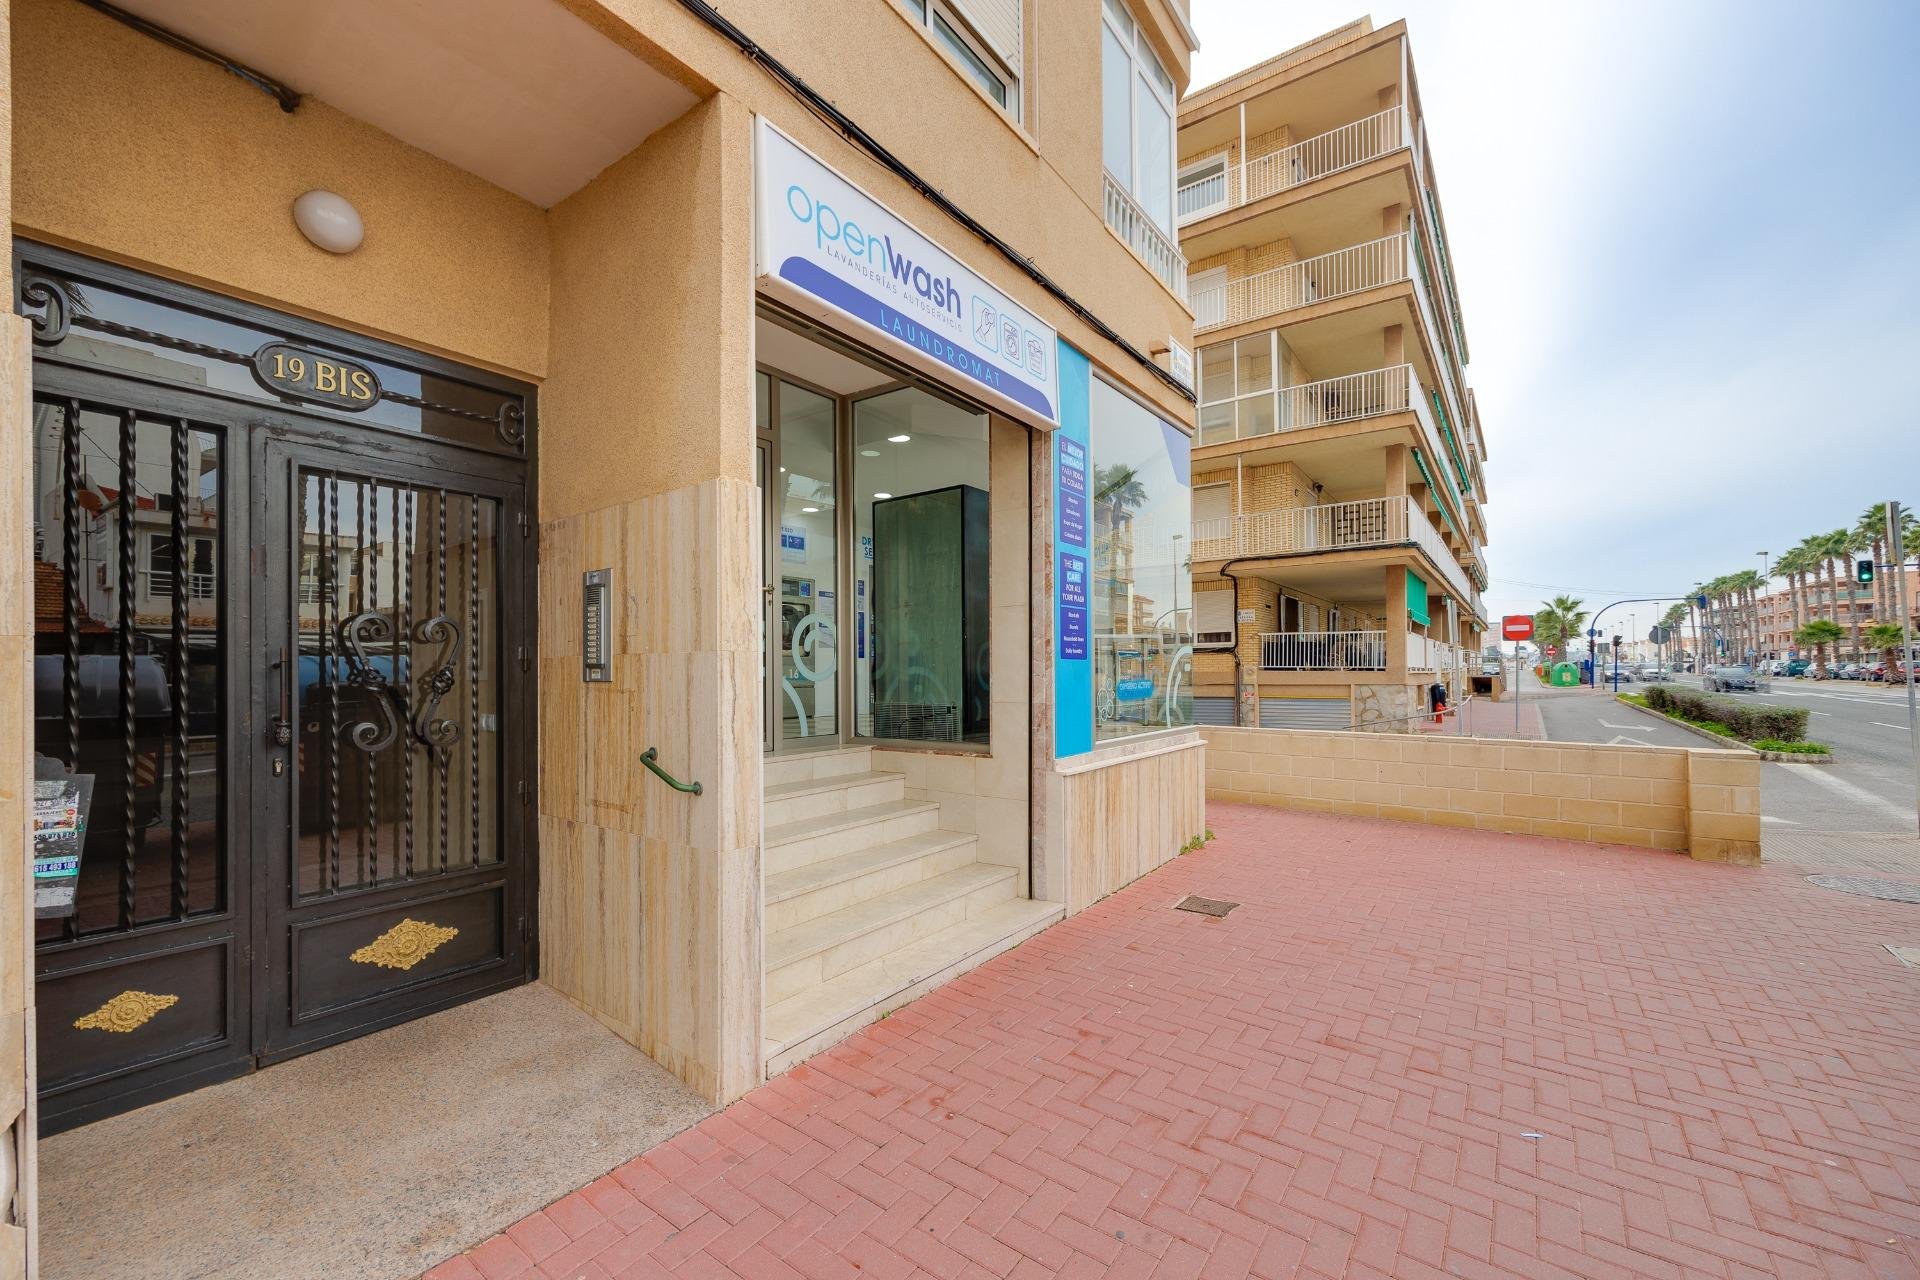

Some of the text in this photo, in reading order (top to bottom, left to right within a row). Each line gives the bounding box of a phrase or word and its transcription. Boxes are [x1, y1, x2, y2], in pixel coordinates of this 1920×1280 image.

[880, 309, 1000, 387] LAUNDROMAT
[273, 353, 371, 400] 19 BIS
[1067, 571, 1081, 583] CARE
